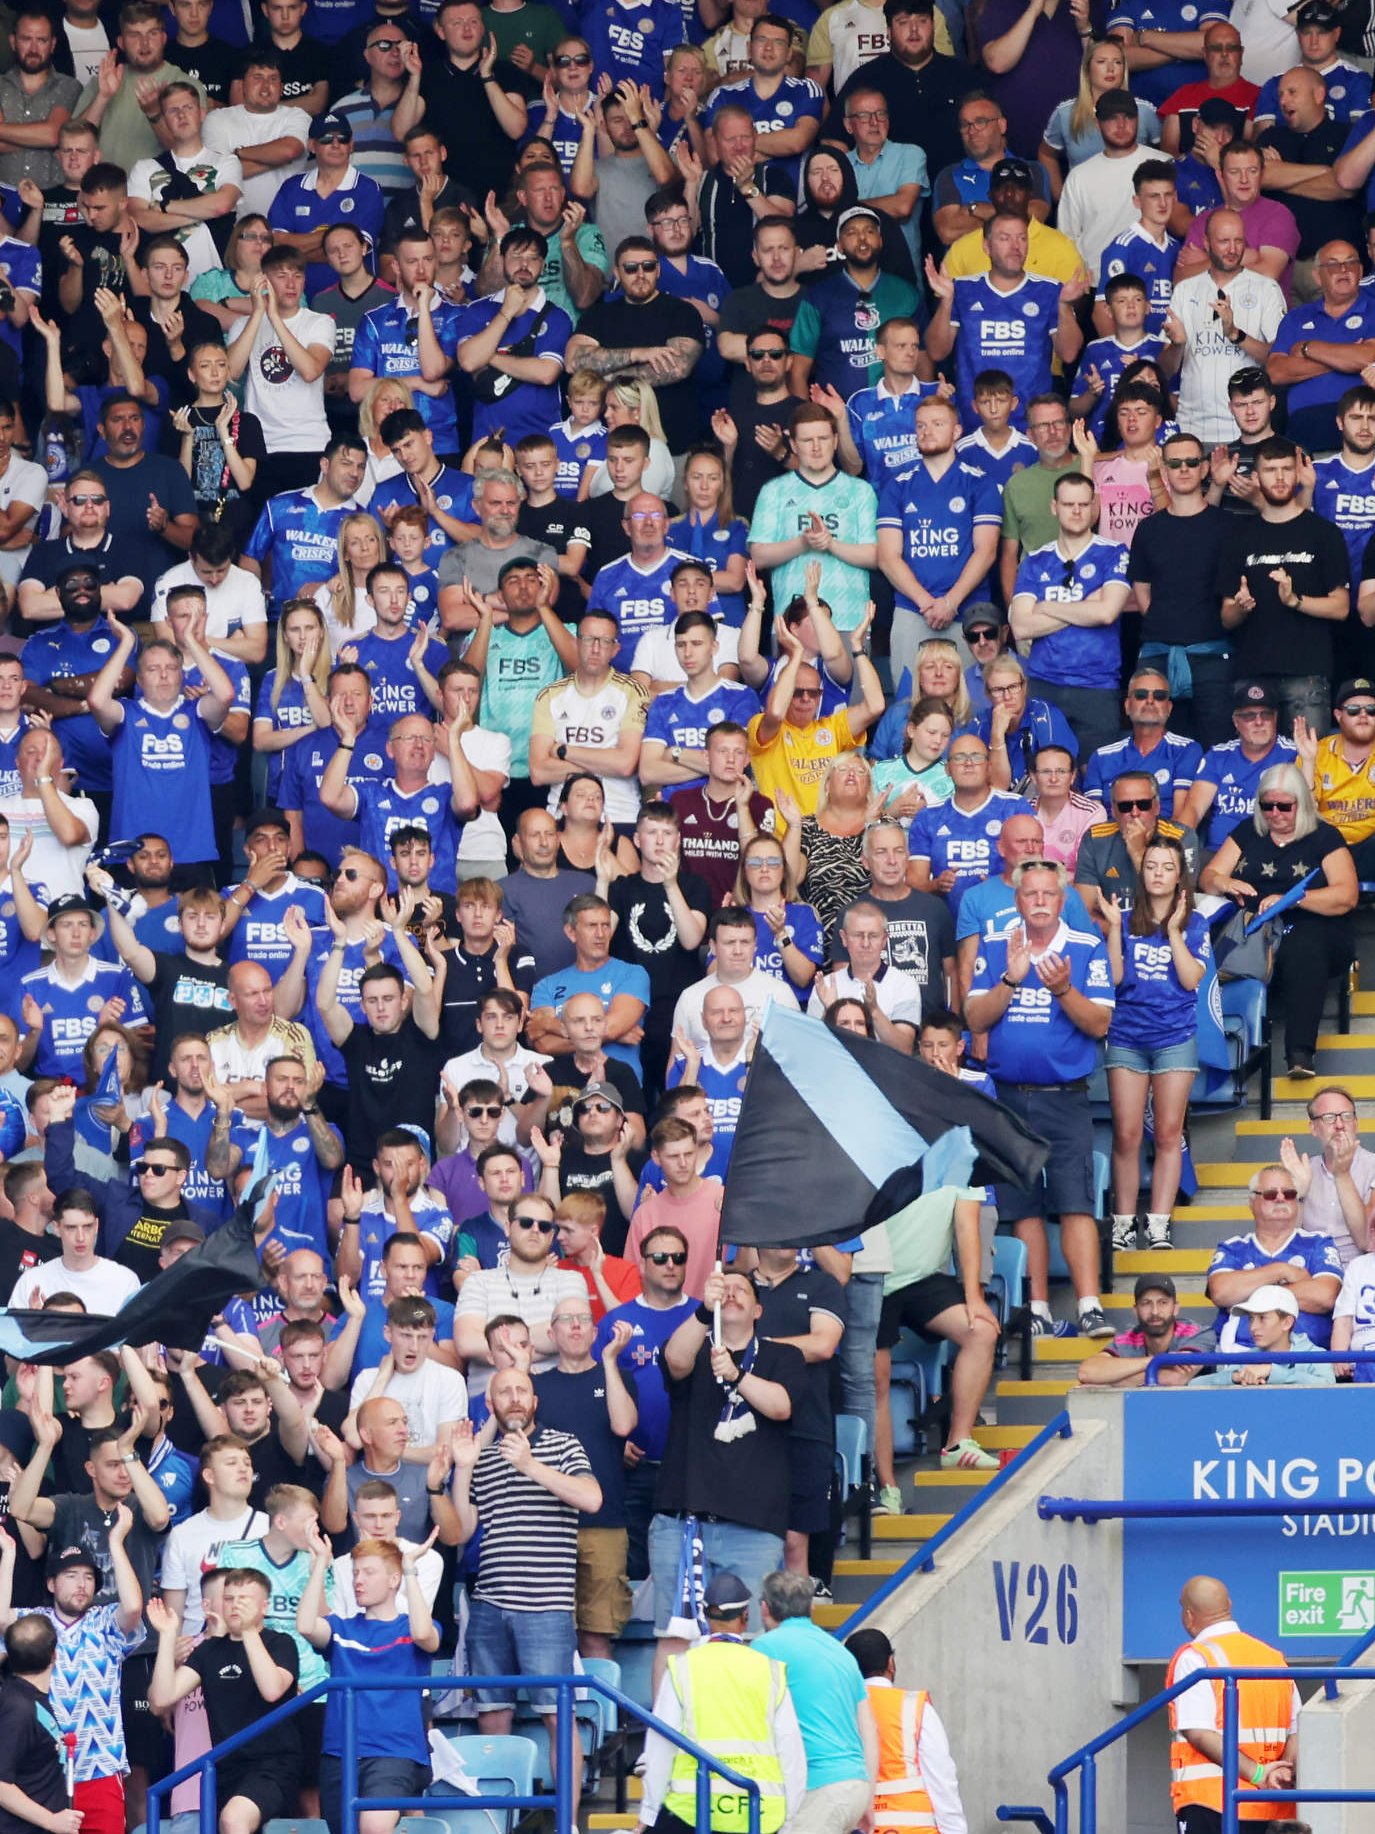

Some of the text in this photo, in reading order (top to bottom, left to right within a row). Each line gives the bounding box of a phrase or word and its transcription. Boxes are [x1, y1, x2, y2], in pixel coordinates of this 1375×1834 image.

[608, 24, 644, 50] FBS
[553, 141, 579, 158] FB
[1152, 279, 1173, 296] FB
[980, 321, 1025, 339] FBS
[1196, 333, 1229, 347] KIN
[1194, 346, 1241, 357] POWER
[558, 462, 580, 476] BS
[1109, 502, 1154, 516] KING
[910, 528, 958, 545] KING
[292, 544, 333, 562] CRISPS
[911, 542, 959, 557] POWER
[621, 599, 665, 616] FBS
[499, 658, 541, 674] FBS
[371, 685, 416, 701] KING
[371, 701, 416, 713] POWER
[565, 727, 604, 743] FBS
[142, 734, 183, 753] FBS
[683, 838, 739, 851] THAILAND
[947, 839, 990, 858] FBS
[722, 851, 738, 860] YOU
[889, 922, 924, 933] BRETTA
[248, 951, 266, 959] trade
[1026, 1015, 1050, 1023] online
[52, 1018, 97, 1038] FBS
[1193, 1458, 1319, 1501] KING
[1286, 1582, 1326, 1601] Fire
[993, 1561, 1078, 1645] V26
[1286, 1607, 1324, 1625] exit
